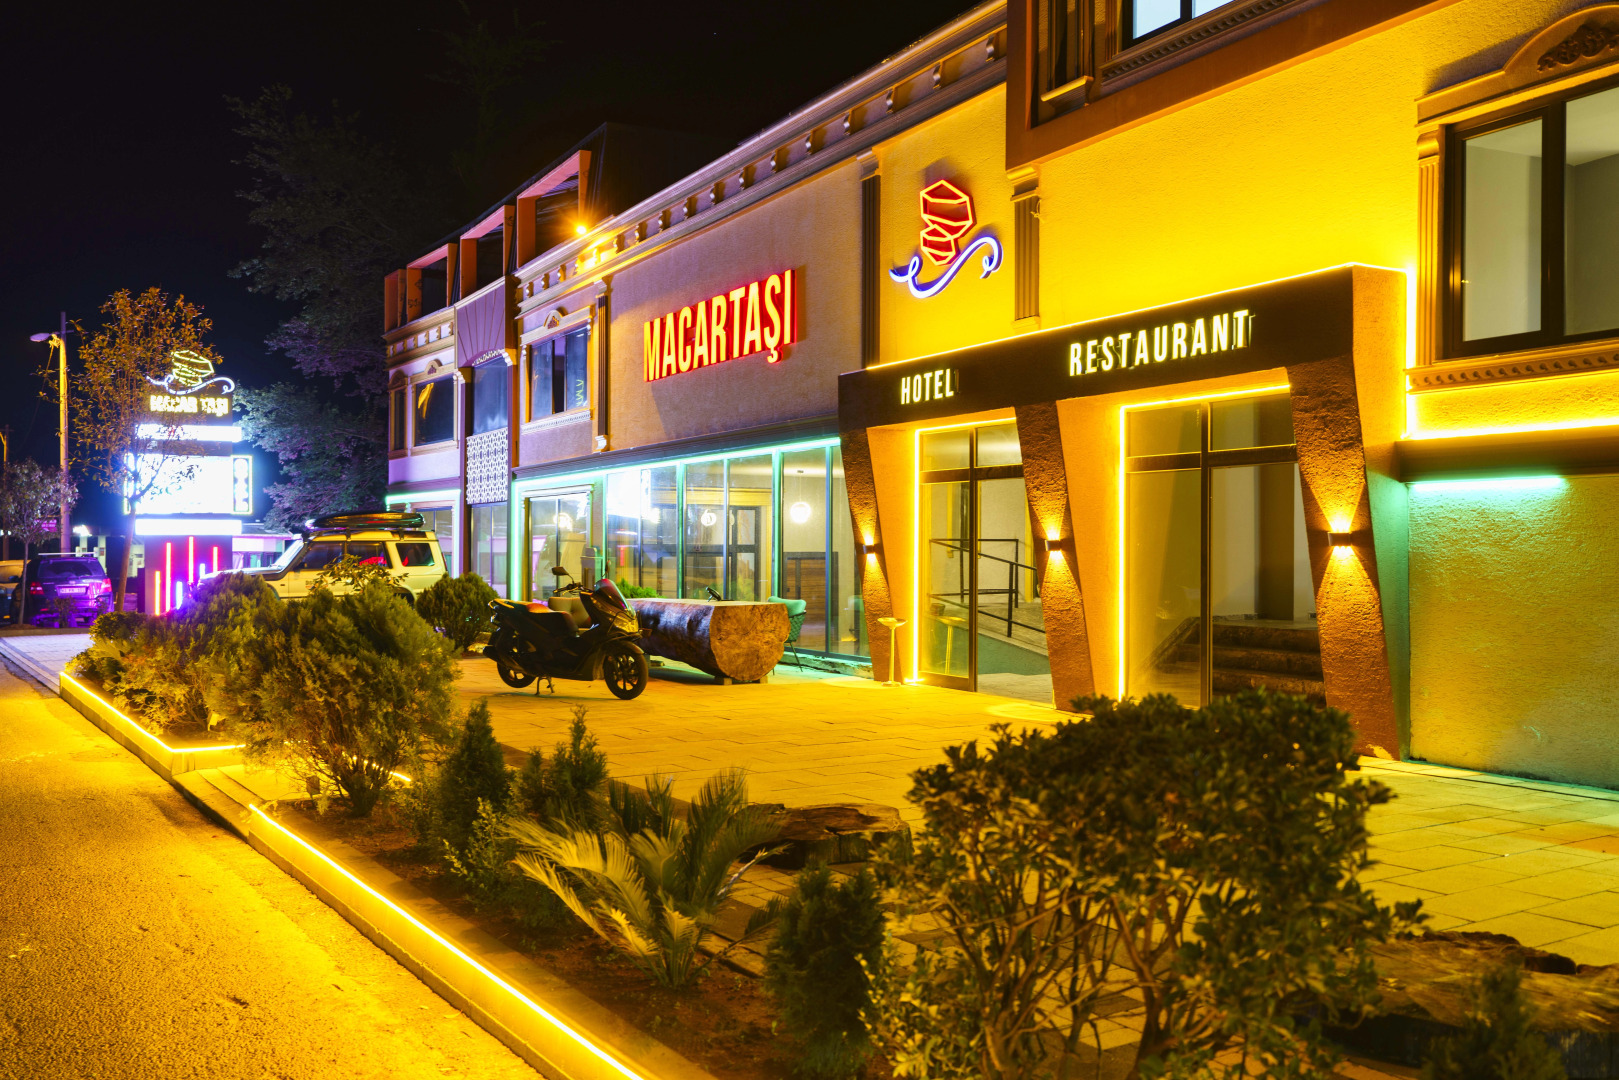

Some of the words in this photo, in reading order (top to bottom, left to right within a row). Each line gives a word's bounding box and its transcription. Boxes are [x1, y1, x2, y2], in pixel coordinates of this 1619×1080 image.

[643, 269, 795, 382] MACARTAŞI
[1069, 309, 1249, 376] RESTAURANT
[901, 368, 955, 405] HOTEL
